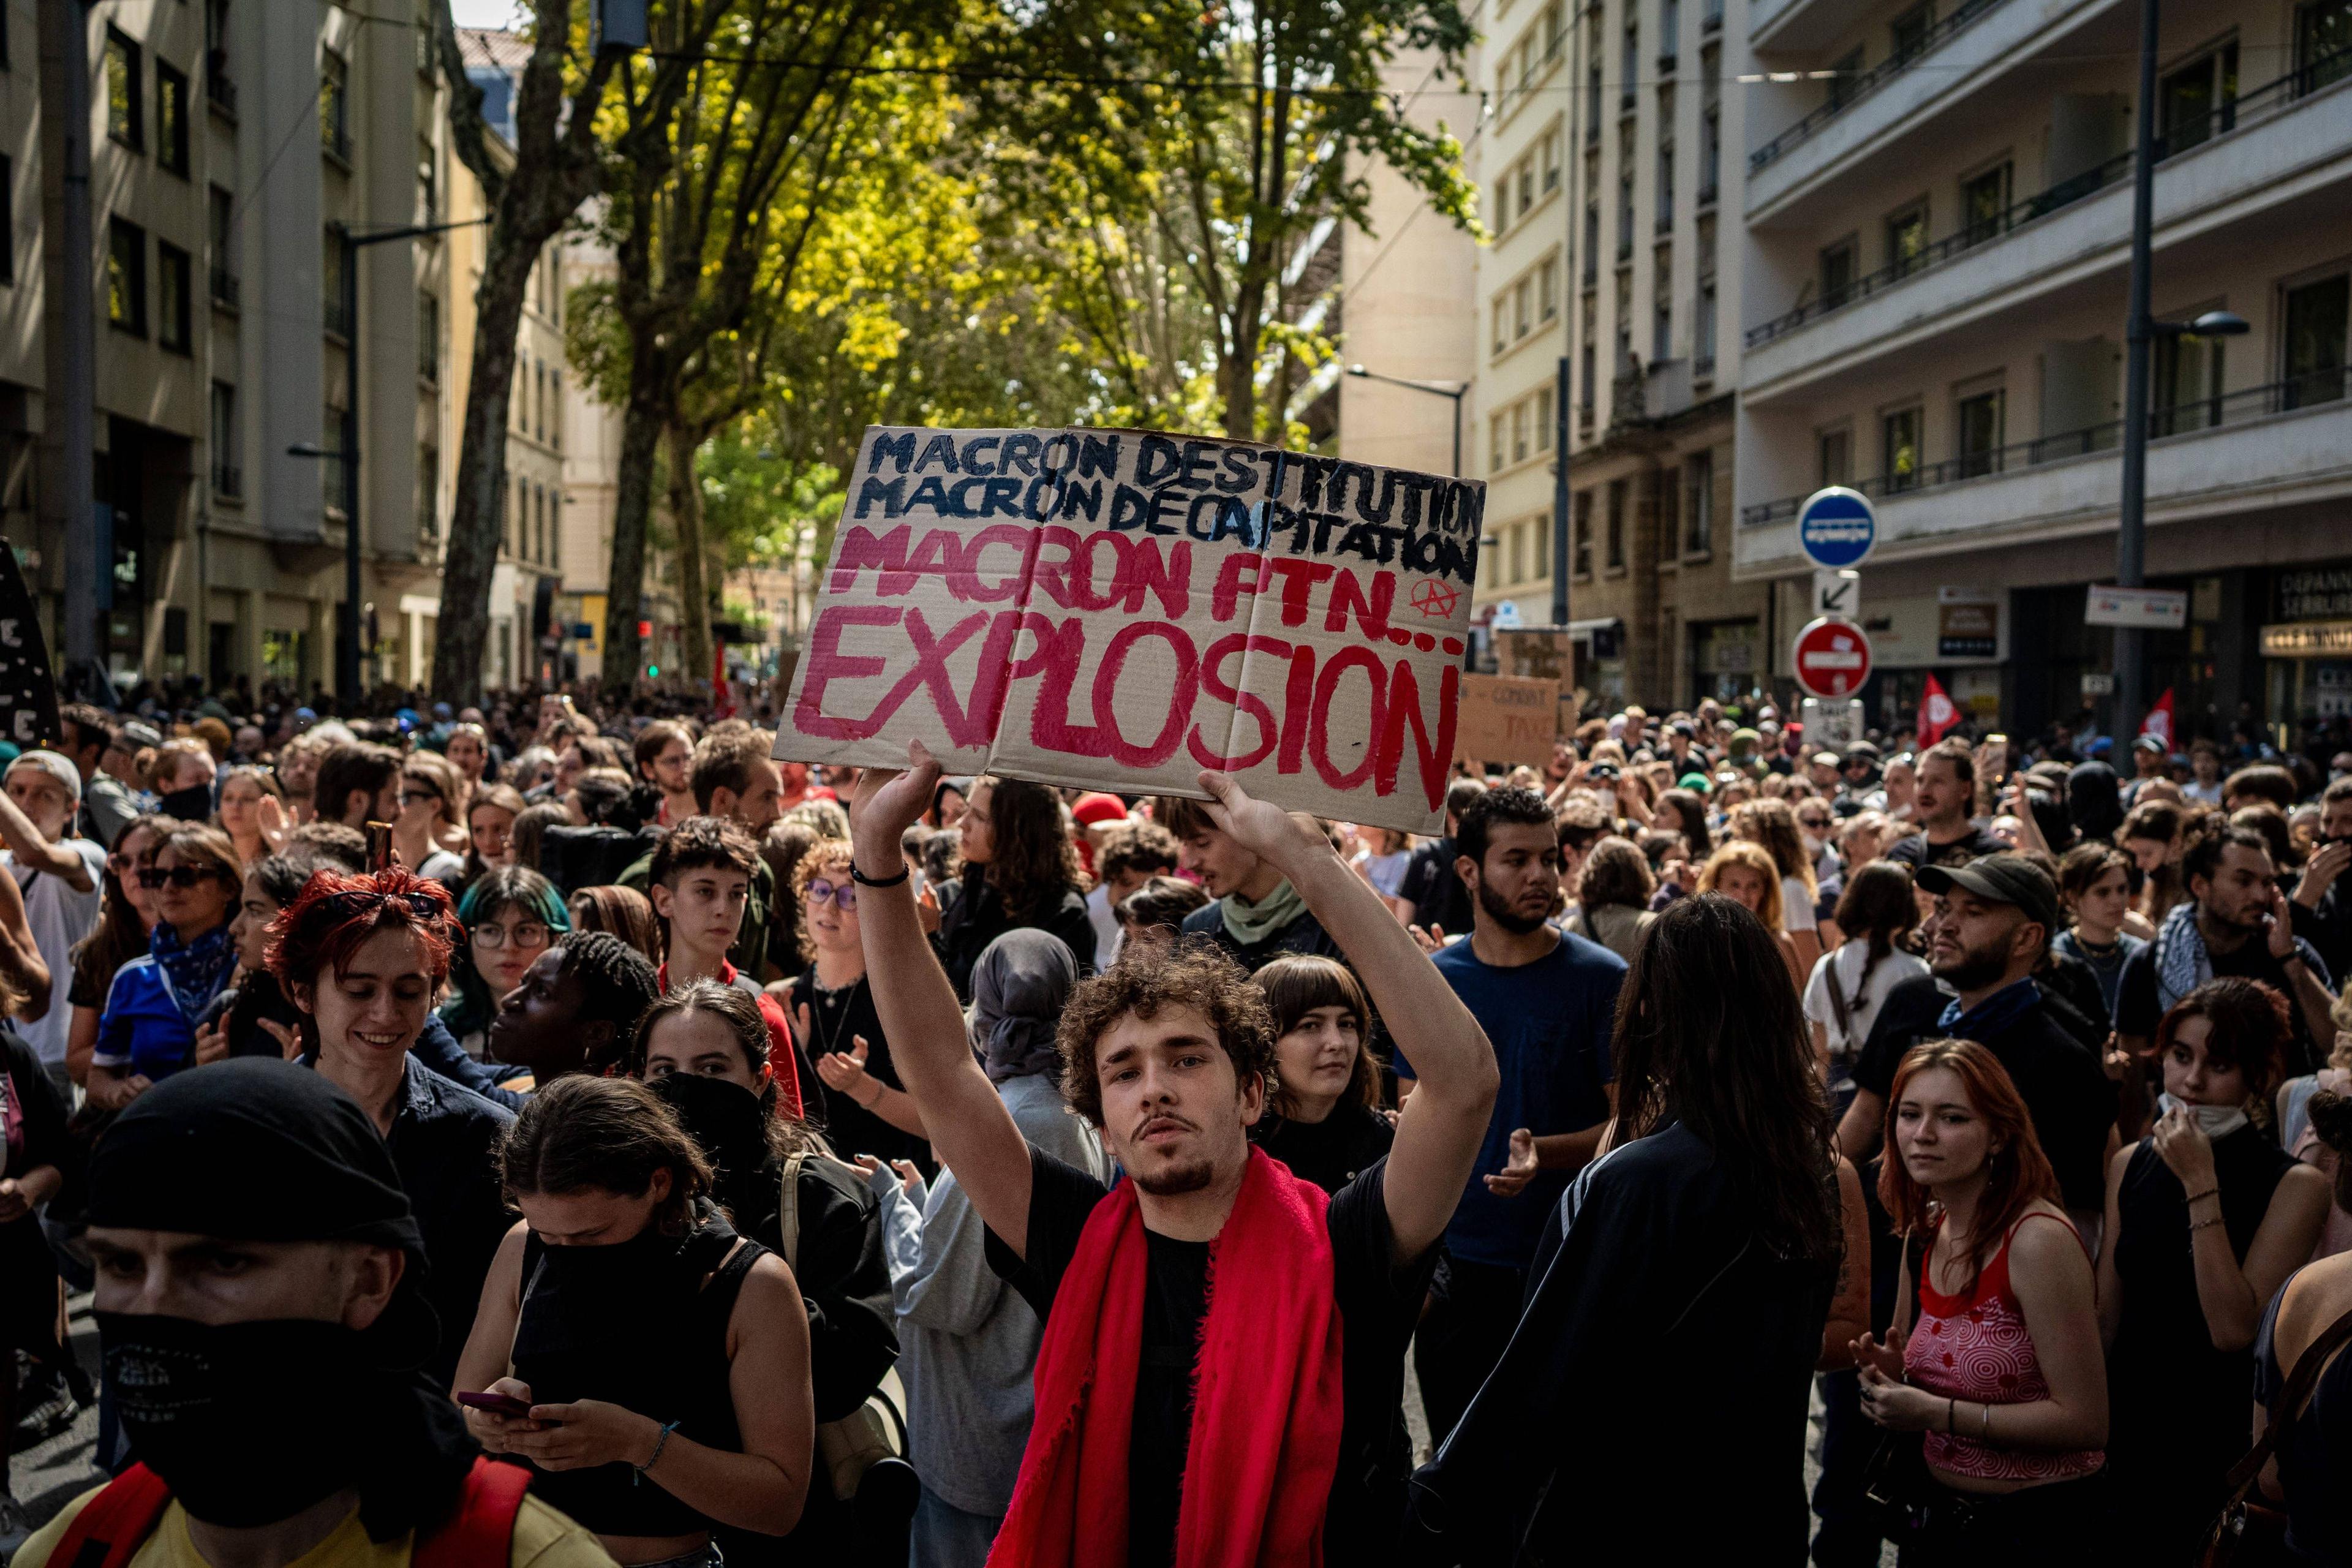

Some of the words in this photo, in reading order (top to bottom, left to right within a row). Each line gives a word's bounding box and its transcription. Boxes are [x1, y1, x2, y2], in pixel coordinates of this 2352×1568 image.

[854, 475, 1102, 522] MACRON
[1109, 482, 1480, 585] DECAPITATION
[868, 431, 1121, 481] MACRON
[1133, 434, 1487, 538] DESTITUTION
[827, 524, 1192, 620] MACRON
[793, 604, 1462, 815] EXPLOSION
